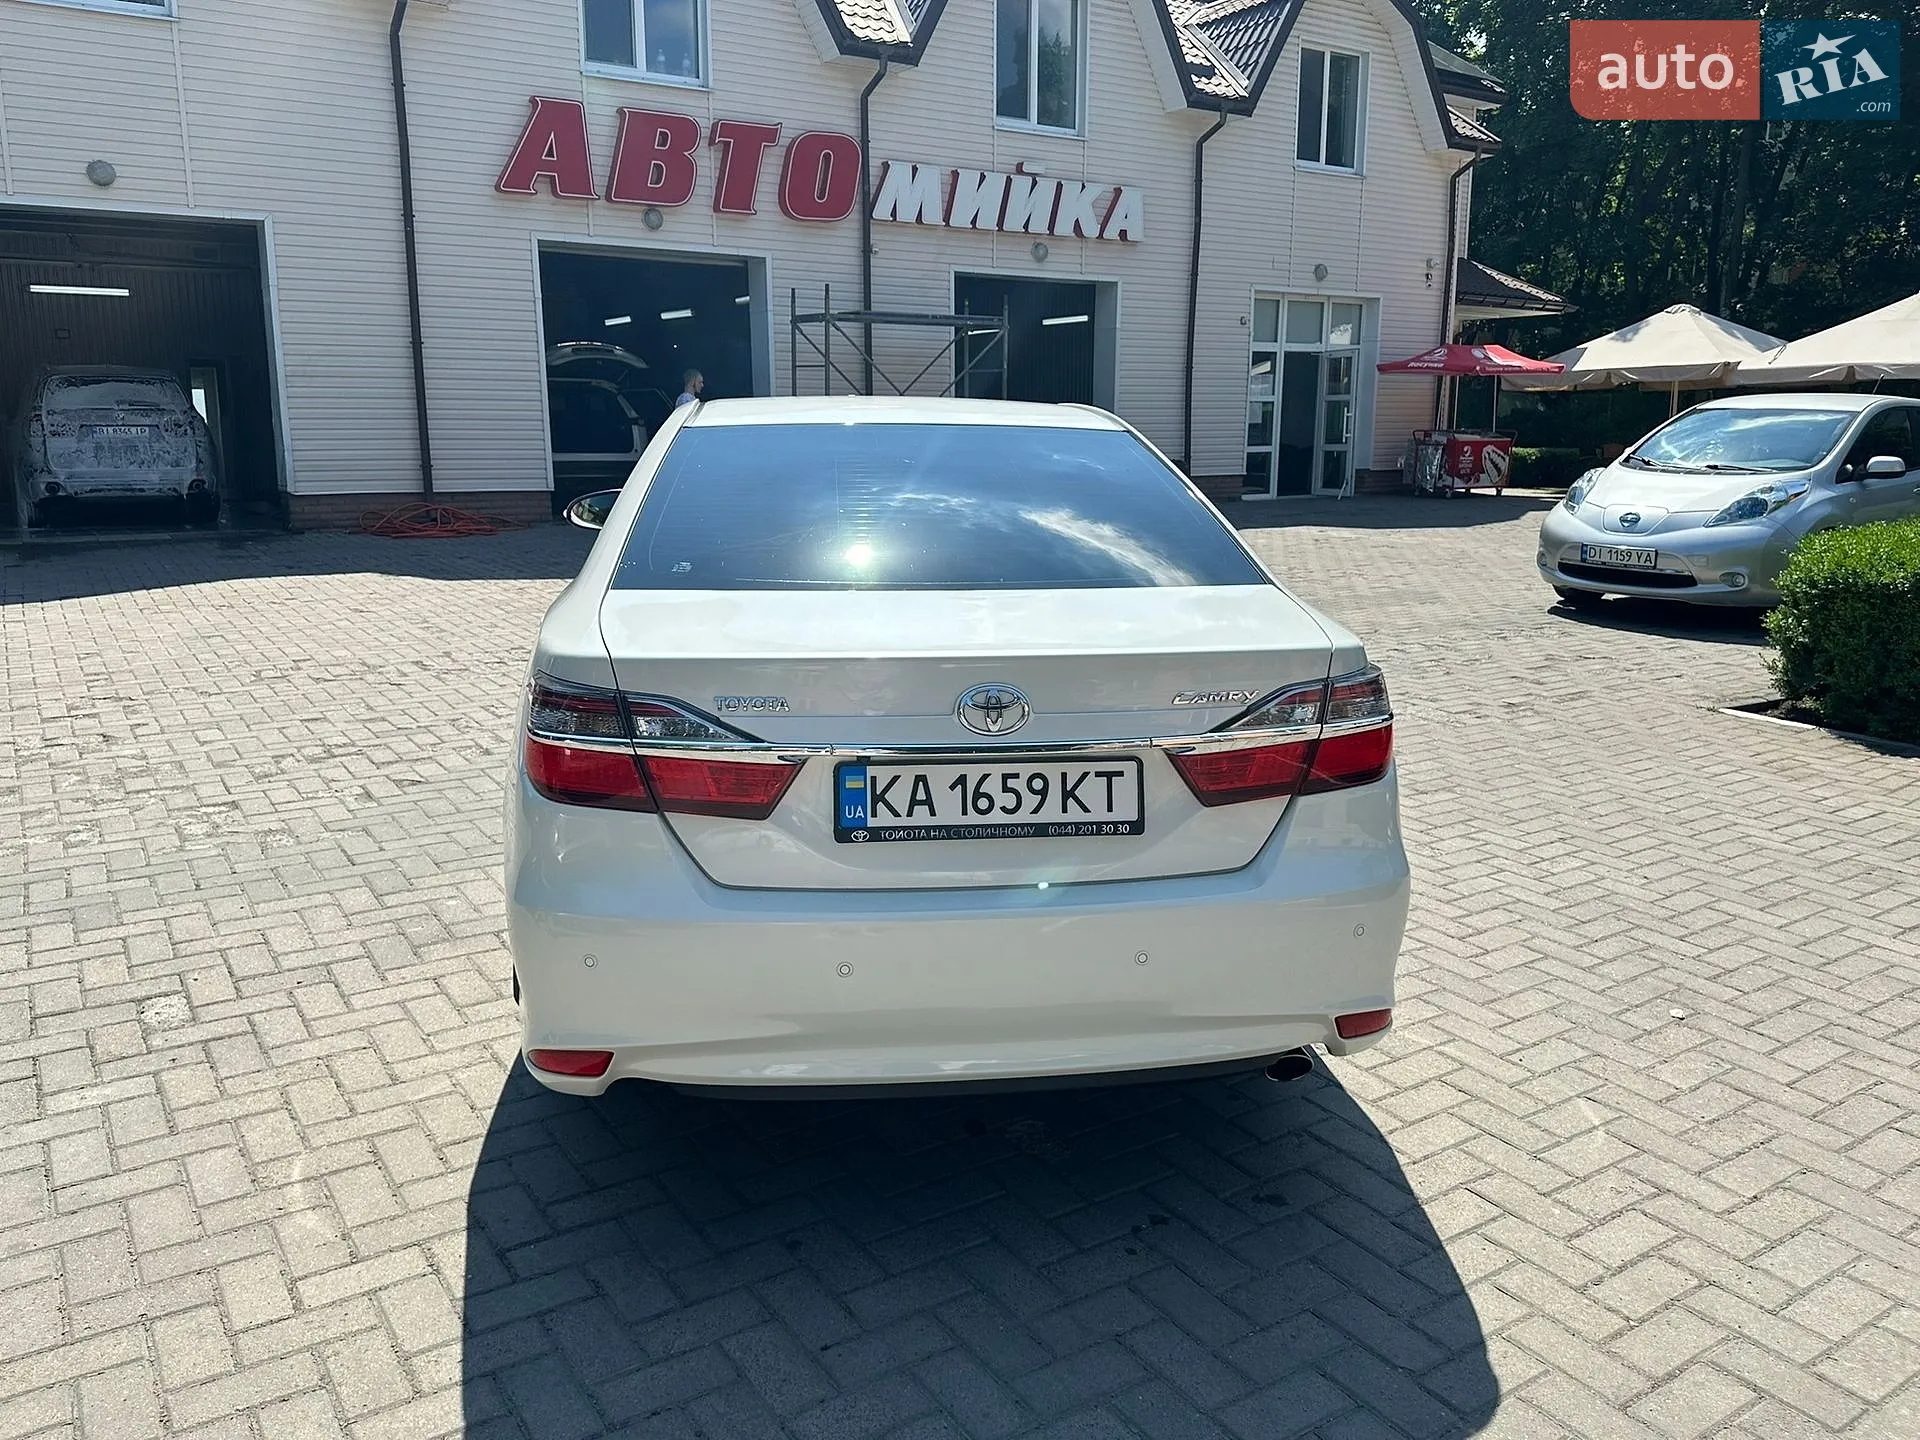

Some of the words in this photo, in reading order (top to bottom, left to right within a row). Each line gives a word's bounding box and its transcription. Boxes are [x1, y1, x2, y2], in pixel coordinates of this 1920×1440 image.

[495, 95, 861, 222] АВТО
[872, 161, 1144, 241] МИЙКА
[1588, 547, 1602, 559] DI
[1607, 550, 1633, 563] 1159
[1636, 552, 1653, 565] YA
[713, 696, 791, 712] TOYOTA
[870, 774, 937, 818] KA
[948, 772, 1050, 817] 1659
[1060, 771, 1125, 814] KT
[845, 805, 864, 818] UA
[930, 828, 948, 839] НА
[950, 825, 1035, 839] СТОЛИЧНОМУ
[1048, 824, 1076, 836] (044)
[1078, 824, 1097, 835] 201
[1101, 823, 1114, 834] 30
[1116, 823, 1130, 834] 30
